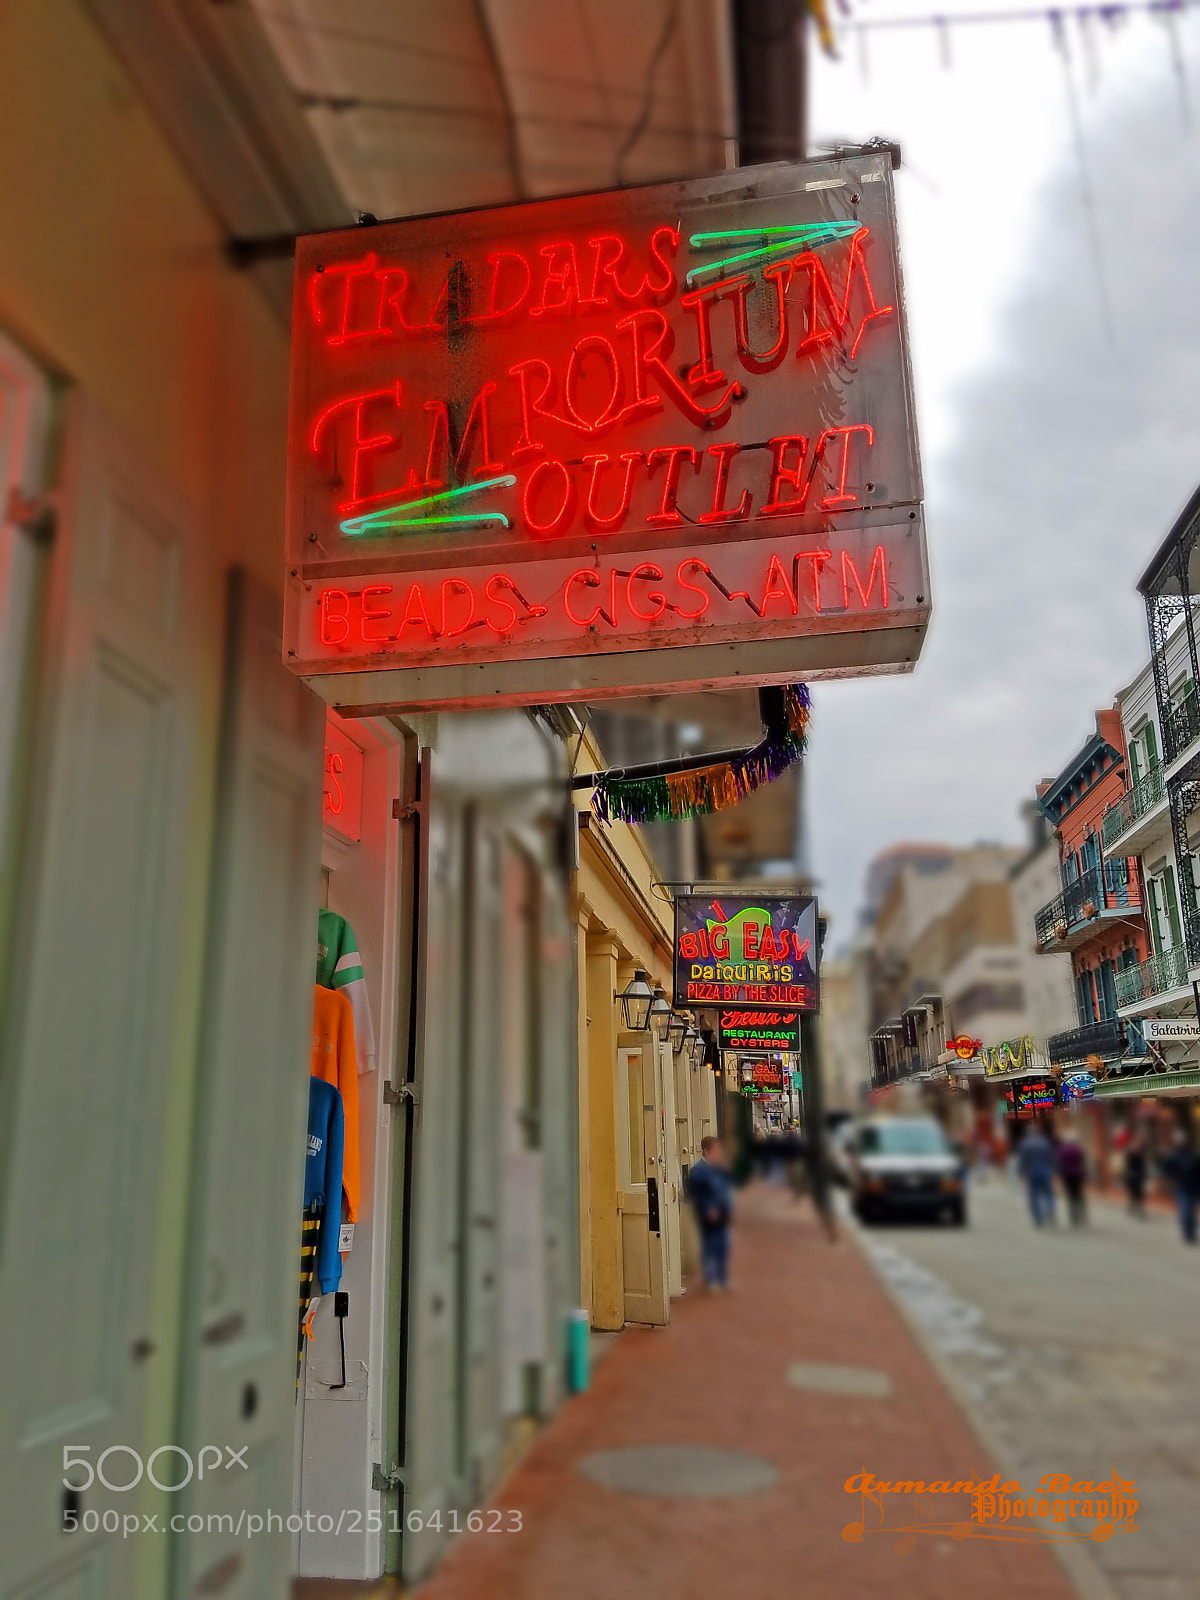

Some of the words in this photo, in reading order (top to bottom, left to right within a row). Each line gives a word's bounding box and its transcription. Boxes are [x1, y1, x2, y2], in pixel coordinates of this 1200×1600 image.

[310, 227, 680, 345] TRADERS
[311, 227, 894, 512] EMPORIUM
[523, 424, 875, 531] OUTLET
[320, 574, 518, 647] BEADS
[563, 558, 710, 628] CIGS
[759, 545, 889, 617] ATM
[679, 924, 730, 960] BIG
[743, 922, 810, 961] EASY
[687, 983, 720, 1000] PIZZA
[723, 984, 741, 1000] BY
[742, 984, 767, 1001] THE
[769, 985, 805, 1003] SLICE
[722, 1029, 797, 1040] RESTAURANT
[730, 1038, 789, 1048] OYSTERS
